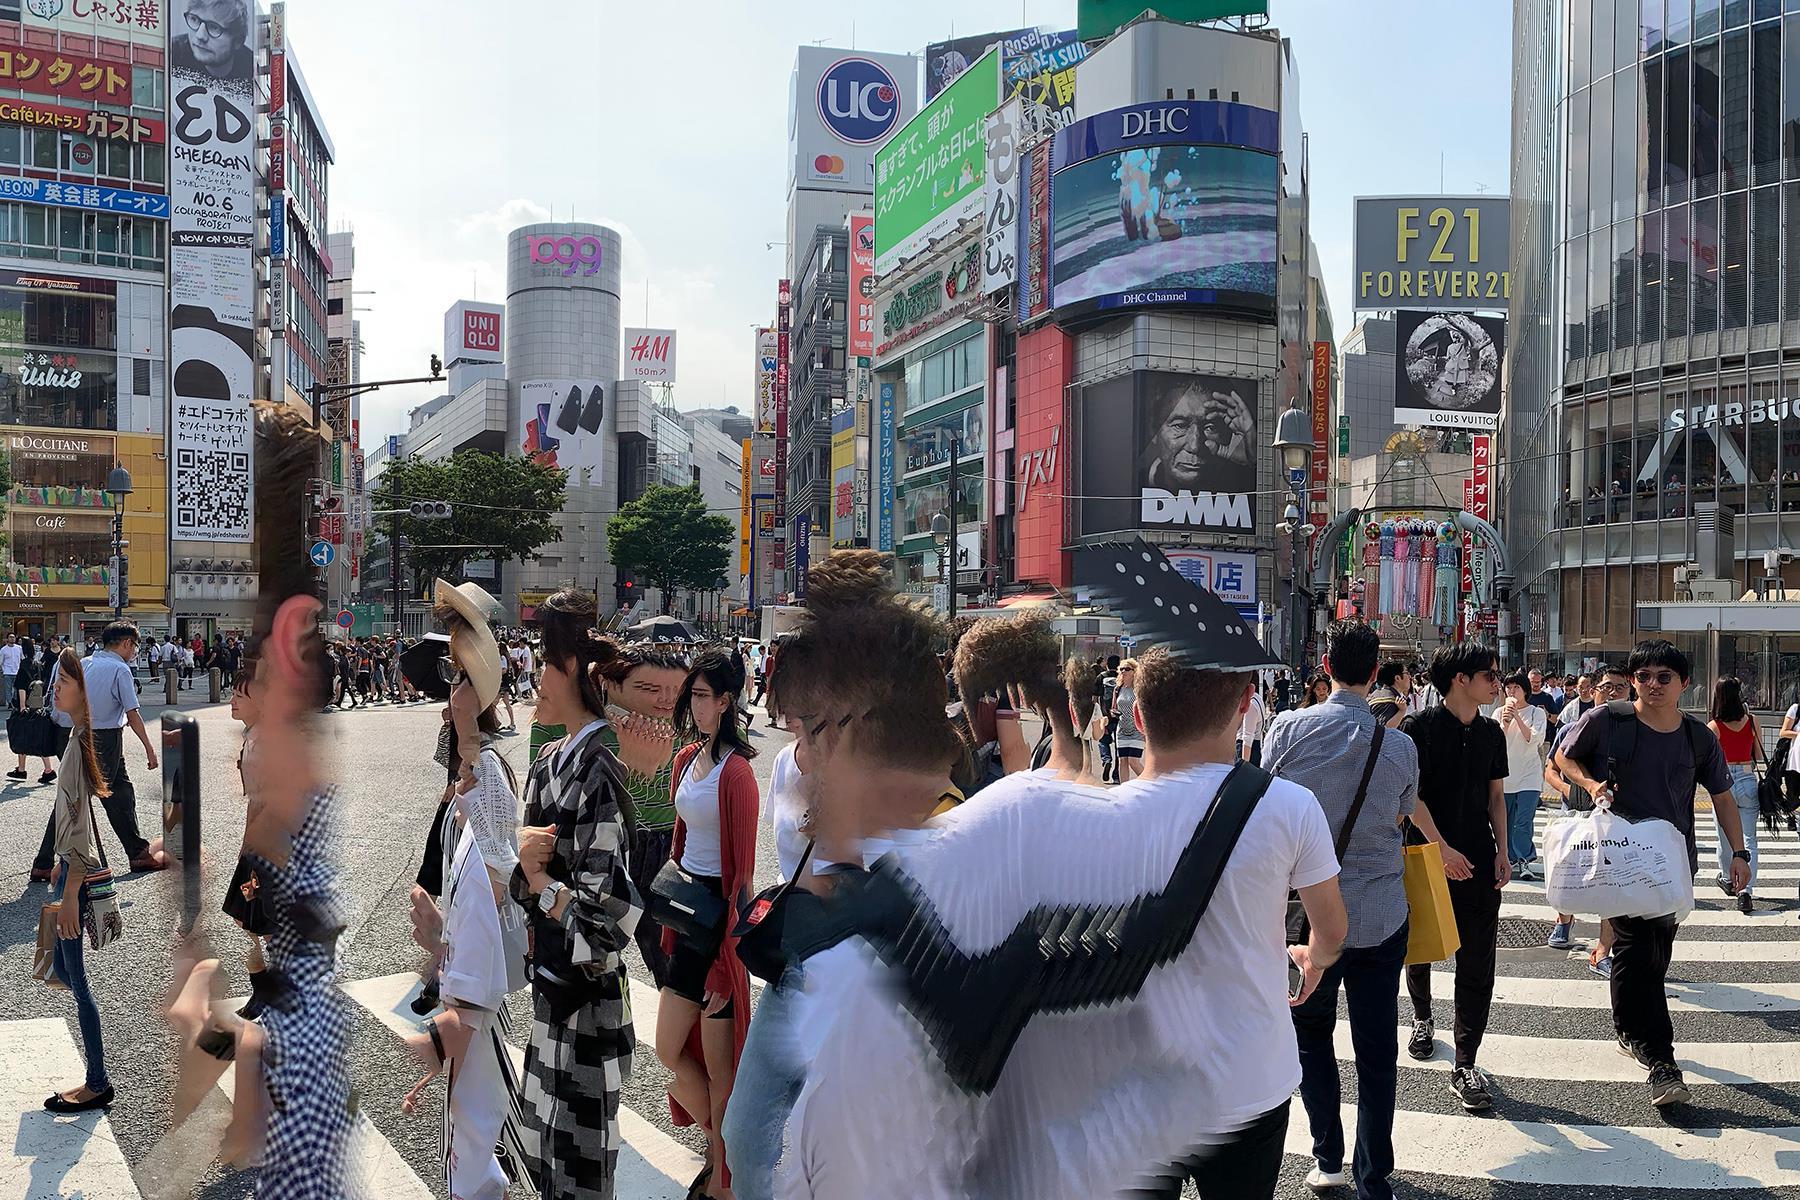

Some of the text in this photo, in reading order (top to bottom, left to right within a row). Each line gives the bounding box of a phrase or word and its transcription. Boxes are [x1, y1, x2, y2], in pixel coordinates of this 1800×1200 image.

[73, 0, 160, 30] しゃぶ葉
[87, 111, 152, 143] ガスト
[175, 85, 251, 146] ED
[1121, 107, 1190, 138] DHC
[174, 145, 252, 172] SHEERAN
[45, 183, 167, 213] 英会話イーオン
[987, 107, 1016, 281] もんじゃ
[174, 205, 253, 224] COLLABORATIONS
[196, 217, 231, 231] PROJECT
[179, 234, 205, 244] NOW
[205, 235, 221, 244] ON
[1398, 207, 1480, 262] F21
[1123, 291, 1187, 304] DHC Channel
[468, 315, 494, 331] UNI
[468, 331, 496, 347] QLO
[631, 335, 670, 363] H&M
[1430, 413, 1459, 423] LOUIS
[12, 435, 89, 452] L'OCCITANE
[1142, 488, 1252, 529] DMM
[36, 515, 66, 531] Café
